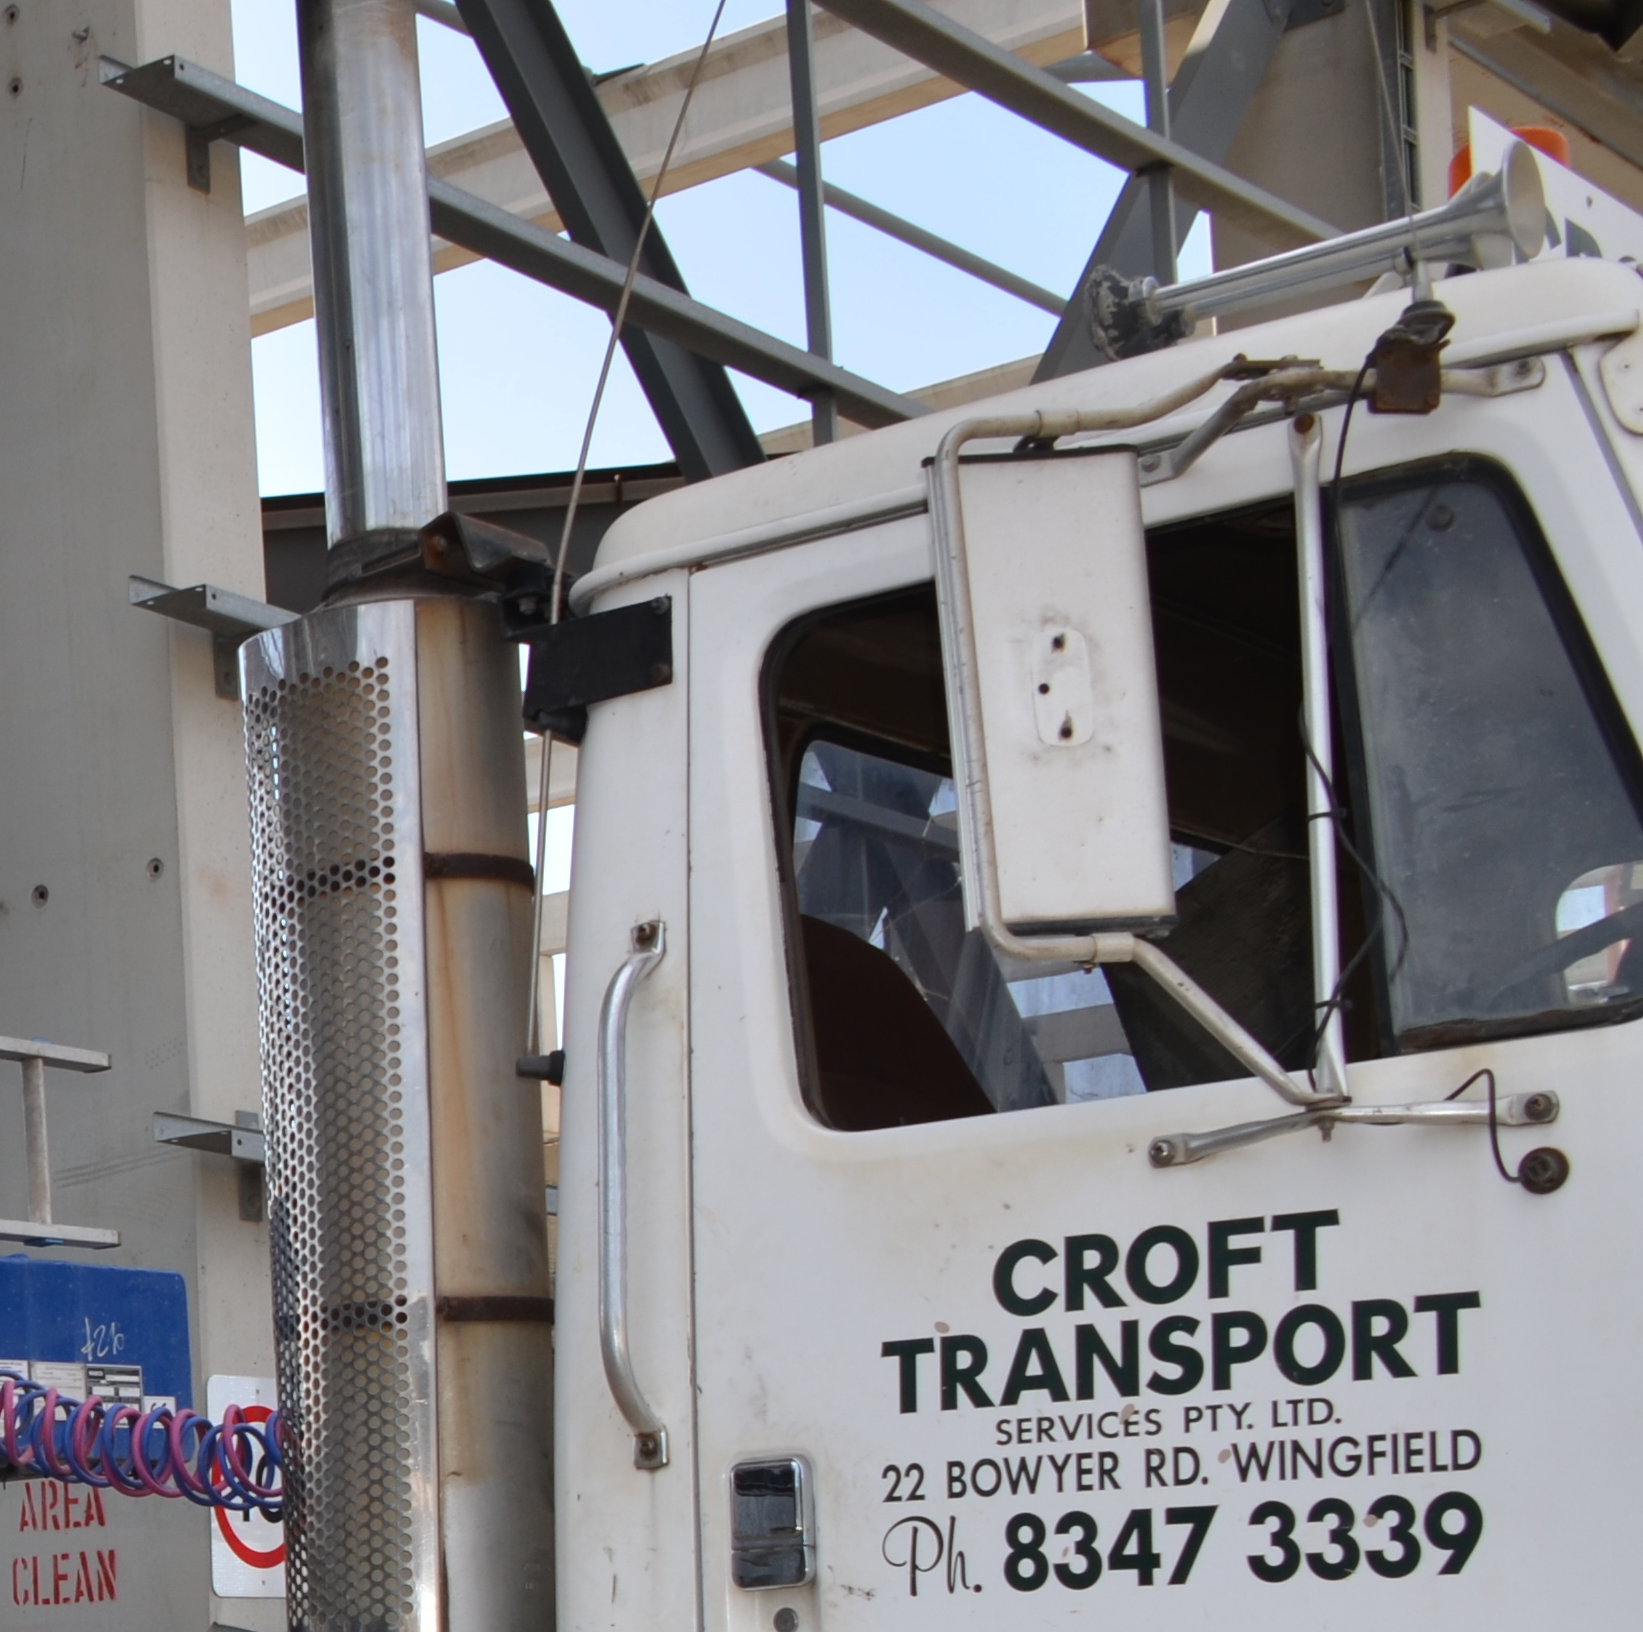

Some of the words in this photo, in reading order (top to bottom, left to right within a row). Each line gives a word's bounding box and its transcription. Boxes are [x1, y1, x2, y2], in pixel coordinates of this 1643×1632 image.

[993, 1208, 1340, 1317] CROFT
[881, 1290, 1481, 1414] TRANSPORT
[996, 1408, 1162, 1446] SERVICES
[1184, 1402, 1254, 1434] PTY.
[1271, 1398, 1342, 1428] LTD.
[882, 1464, 925, 1503] 22
[947, 1451, 1121, 1499] BOWYER
[1144, 1446, 1209, 1488] RD.
[1230, 1429, 1482, 1483] WINGFIELD
[19, 1481, 106, 1532] AREA
[11, 1549, 117, 1606] CLEAN
[882, 1515, 983, 1597] Ph.
[1003, 1504, 1219, 1592] 8347
[1247, 1491, 1483, 1583] 3339
